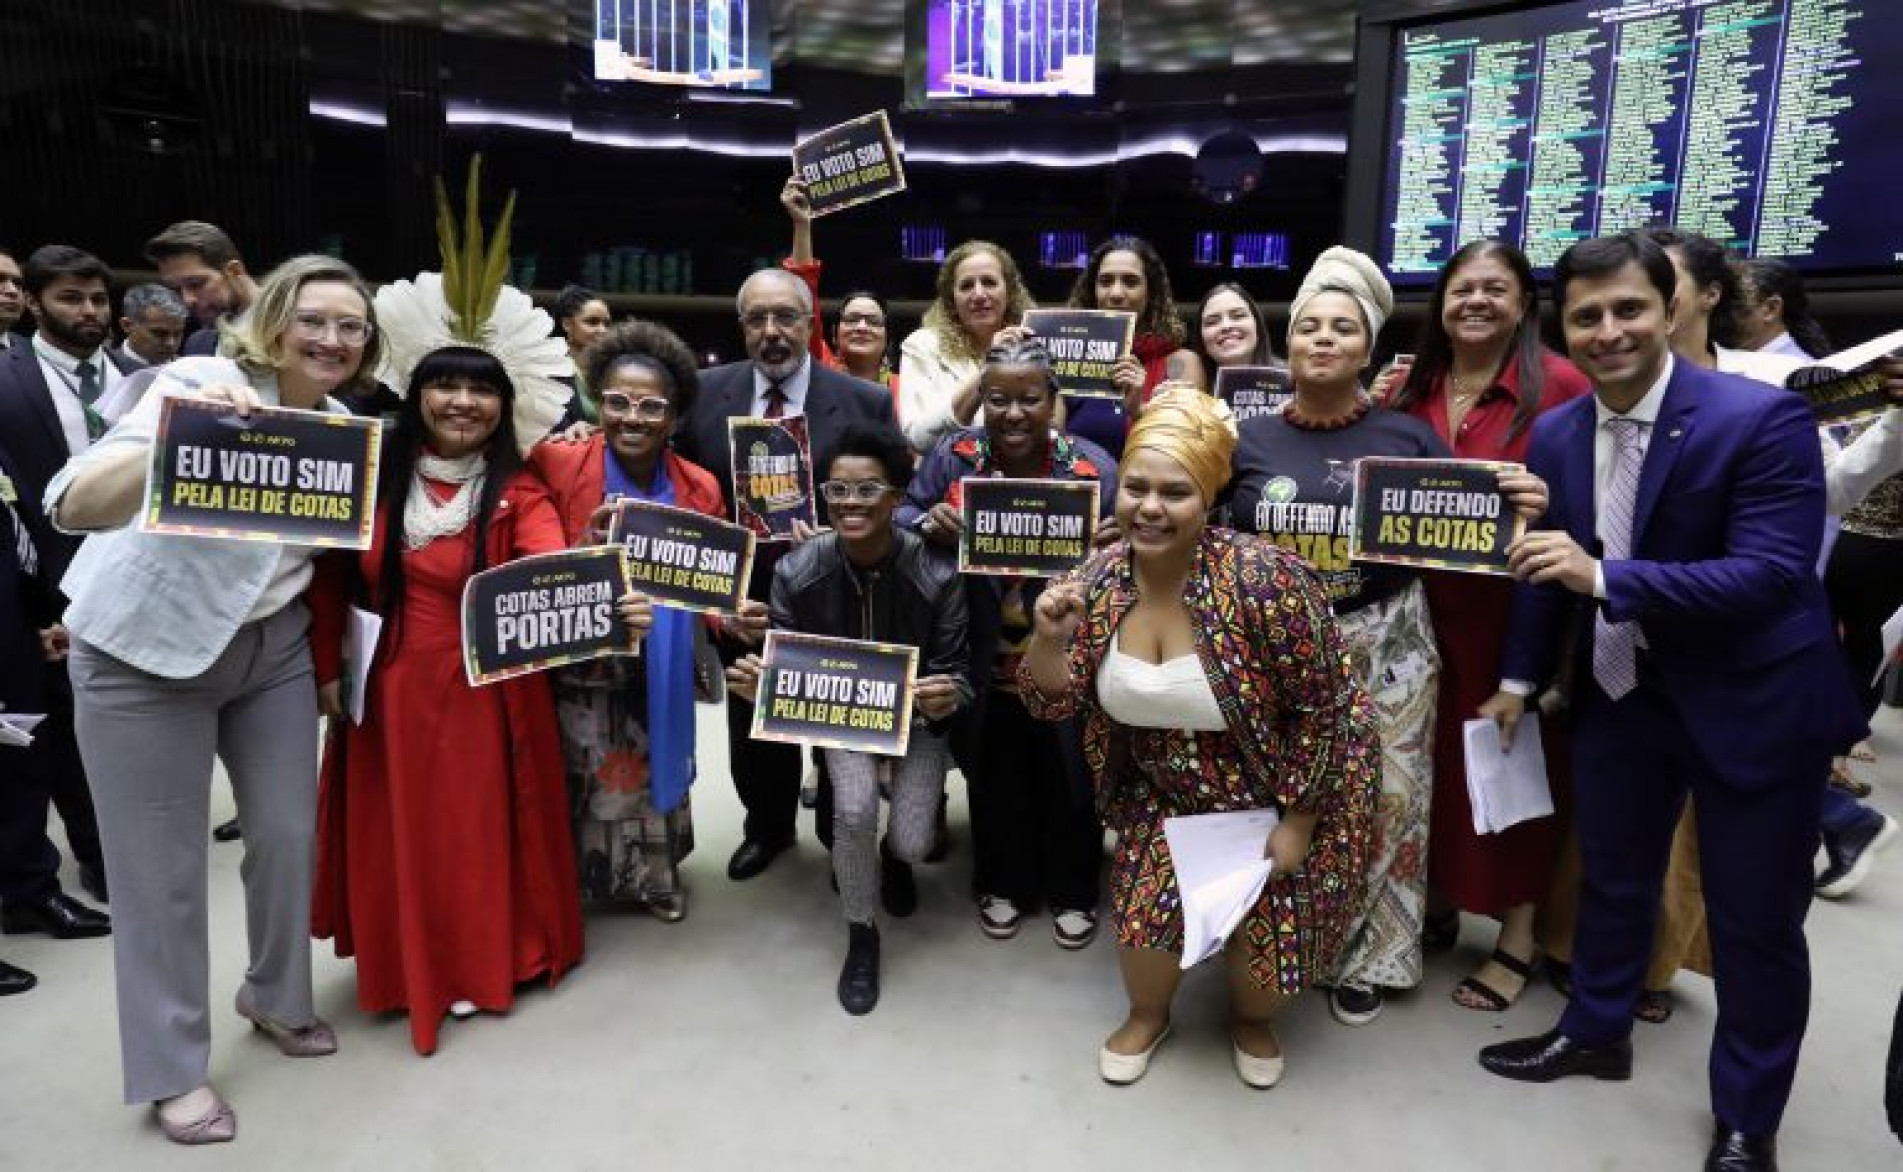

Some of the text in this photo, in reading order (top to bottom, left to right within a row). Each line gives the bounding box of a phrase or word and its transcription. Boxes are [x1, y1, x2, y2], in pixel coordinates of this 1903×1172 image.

[820, 151, 856, 177] VOTO
[855, 142, 885, 167] SIM
[1085, 339, 1118, 360] SIM
[176, 446, 353, 493] EU VOTO SIM
[173, 481, 352, 520] PELA LEI DE COTAS
[1382, 488, 1500, 518] EU DEFENDO
[976, 510, 1083, 539] EU VOTO SIM
[1379, 515, 1497, 553] AS COTAS
[627, 534, 737, 576] EU VOTO SIM
[628, 560, 652, 580] ELA
[694, 572, 733, 595] COTAS
[495, 580, 612, 615] COTAS ABREM
[497, 604, 612, 655] PORTAS
[776, 669, 897, 708] EU VOTO SIM
[773, 698, 893, 731] PELA LEI DE COTAS
